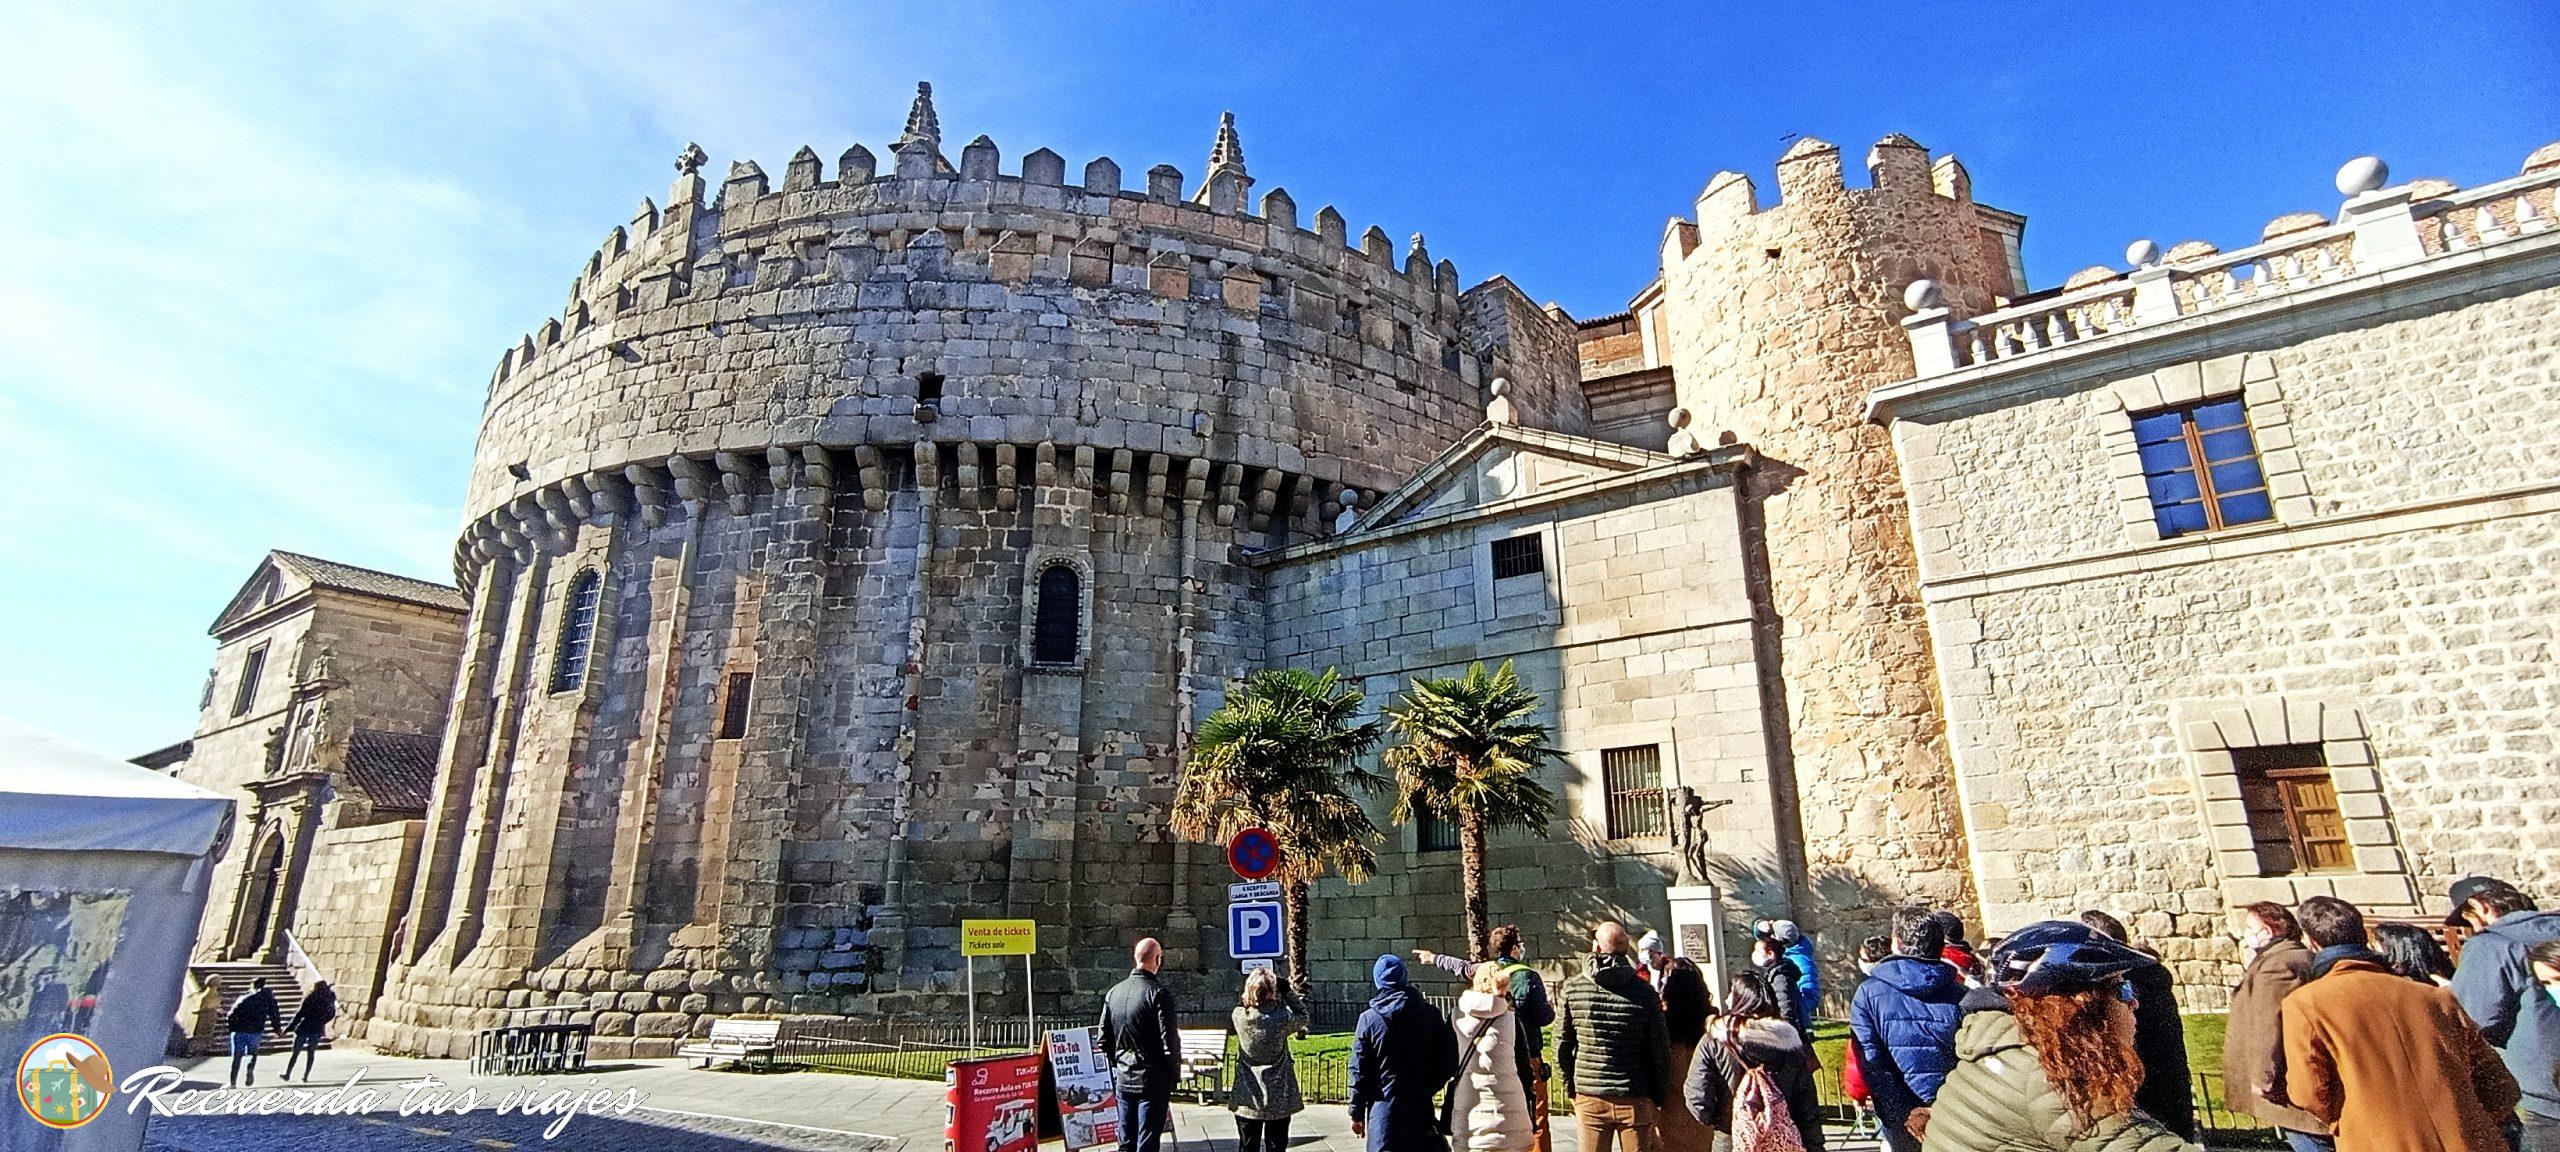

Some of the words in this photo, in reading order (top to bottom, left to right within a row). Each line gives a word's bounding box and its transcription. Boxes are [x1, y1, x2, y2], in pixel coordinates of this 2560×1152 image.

[1242, 884, 1267, 892] EXCEPTO
[968, 927, 991, 936] Venta
[992, 927, 1003, 936] de
[1004, 926, 1031, 936] tickets
[1240, 910, 1270, 951] P
[969, 941, 991, 949] Tickets
[992, 941, 1005, 949] sale
[1051, 1033, 1066, 1043] Este
[1052, 1042, 1080, 1054] Tuk-Tuk
[1055, 1056, 1064, 1066] es
[1064, 1054, 1080, 1064] solo
[1056, 1066, 1073, 1078] para
[973, 1087, 999, 1096] Recorre
[1000, 1083, 1014, 1093] Ávila
